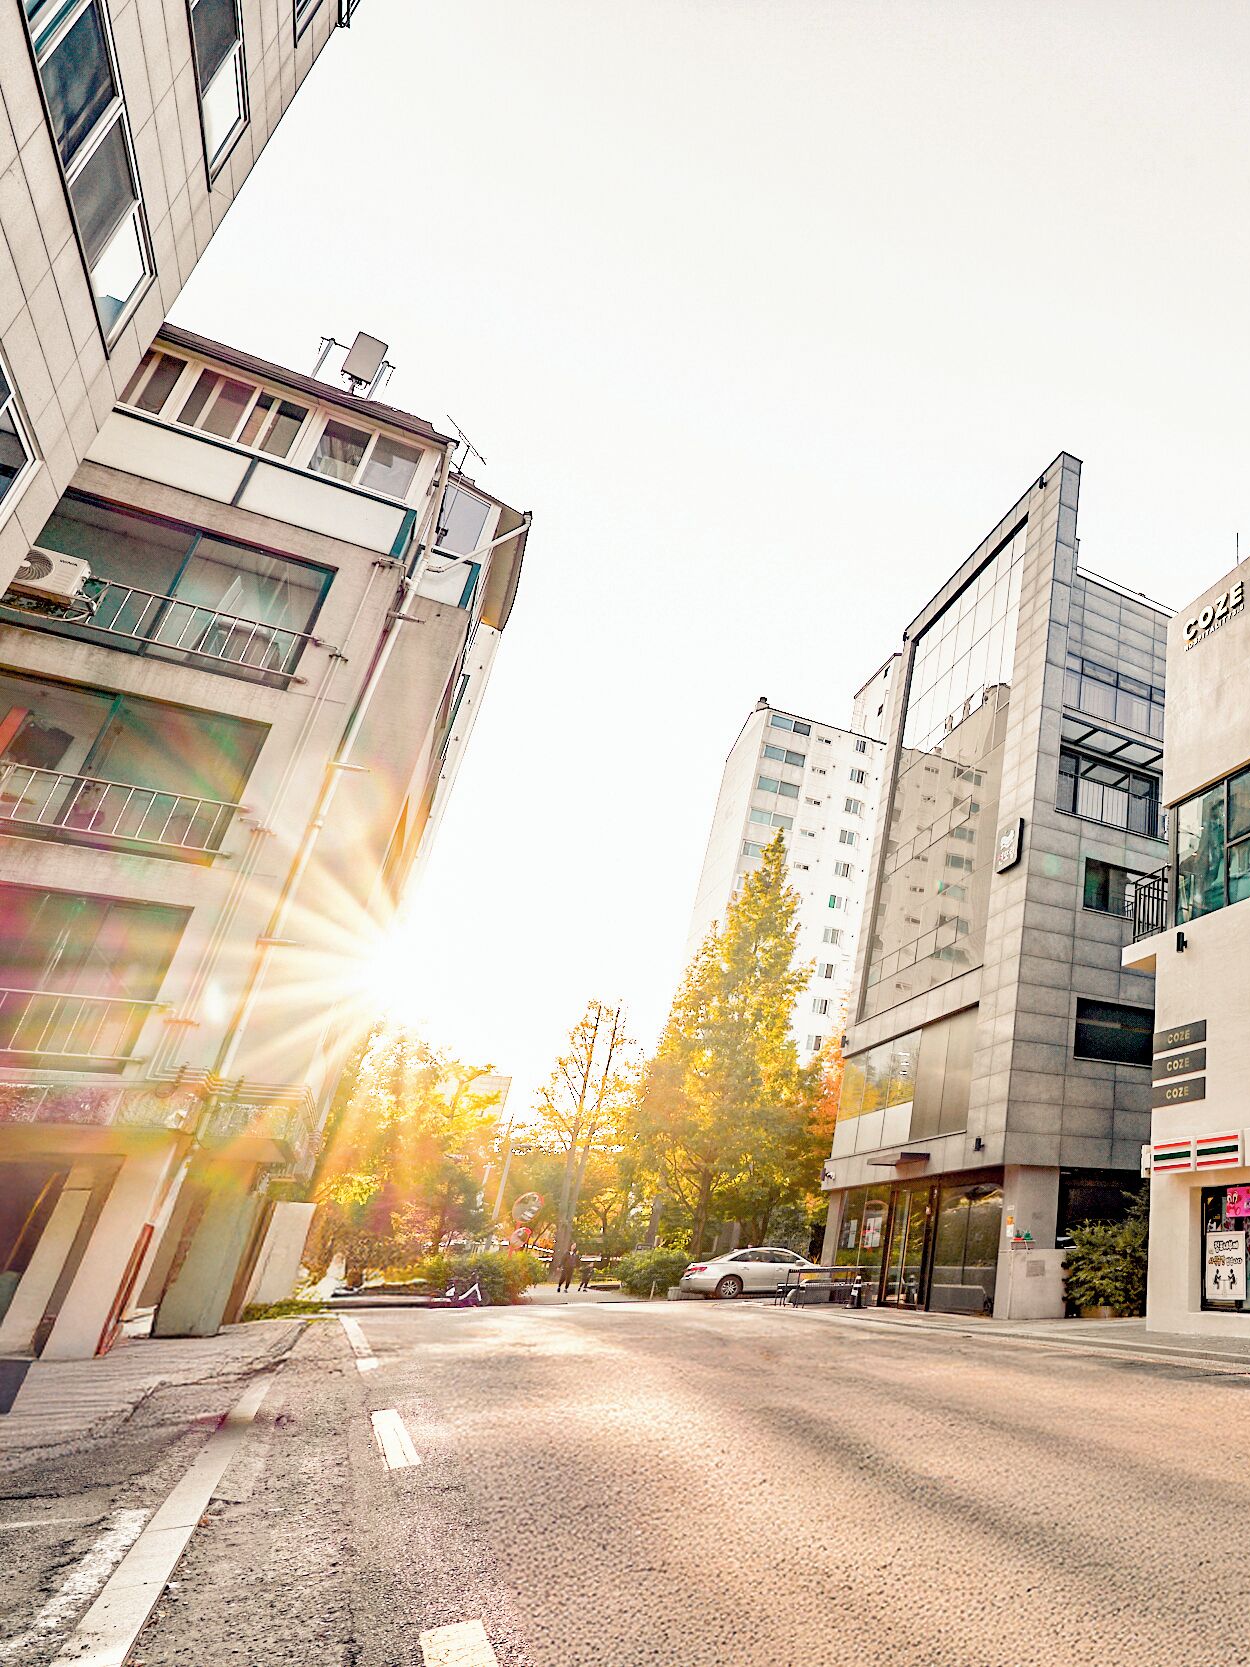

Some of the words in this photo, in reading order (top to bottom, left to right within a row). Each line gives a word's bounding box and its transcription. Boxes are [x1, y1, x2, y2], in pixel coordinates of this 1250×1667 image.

[1182, 580, 1244, 642] COZE
[1167, 1029, 1191, 1044] COZE
[1166, 1057, 1190, 1072] COZE
[1165, 1086, 1190, 1100] COZE
